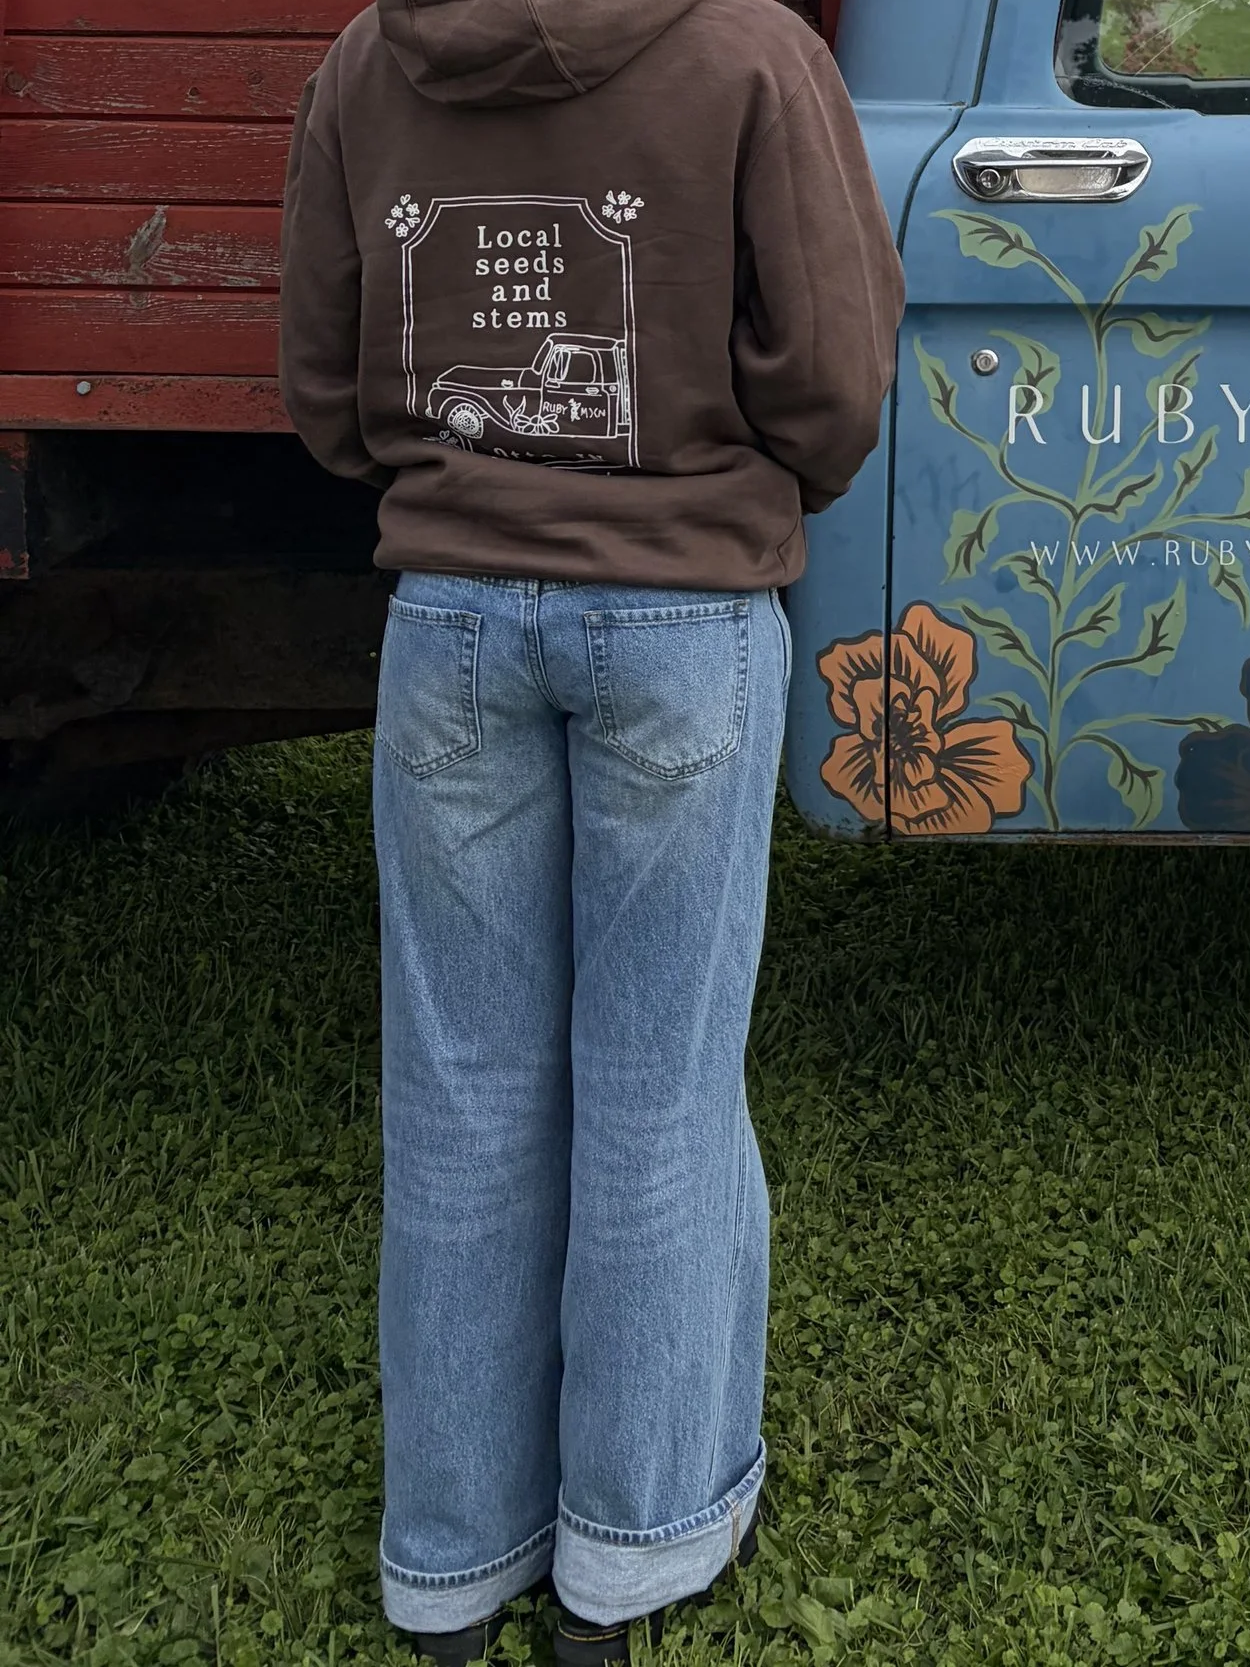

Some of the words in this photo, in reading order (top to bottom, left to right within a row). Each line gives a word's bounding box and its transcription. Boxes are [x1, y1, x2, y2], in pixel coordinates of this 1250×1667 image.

[477, 223, 562, 249] Local
[475, 250, 565, 276] seeds
[491, 277, 552, 302] and
[472, 308, 567, 329] stems
[543, 401, 568, 415] RUBY
